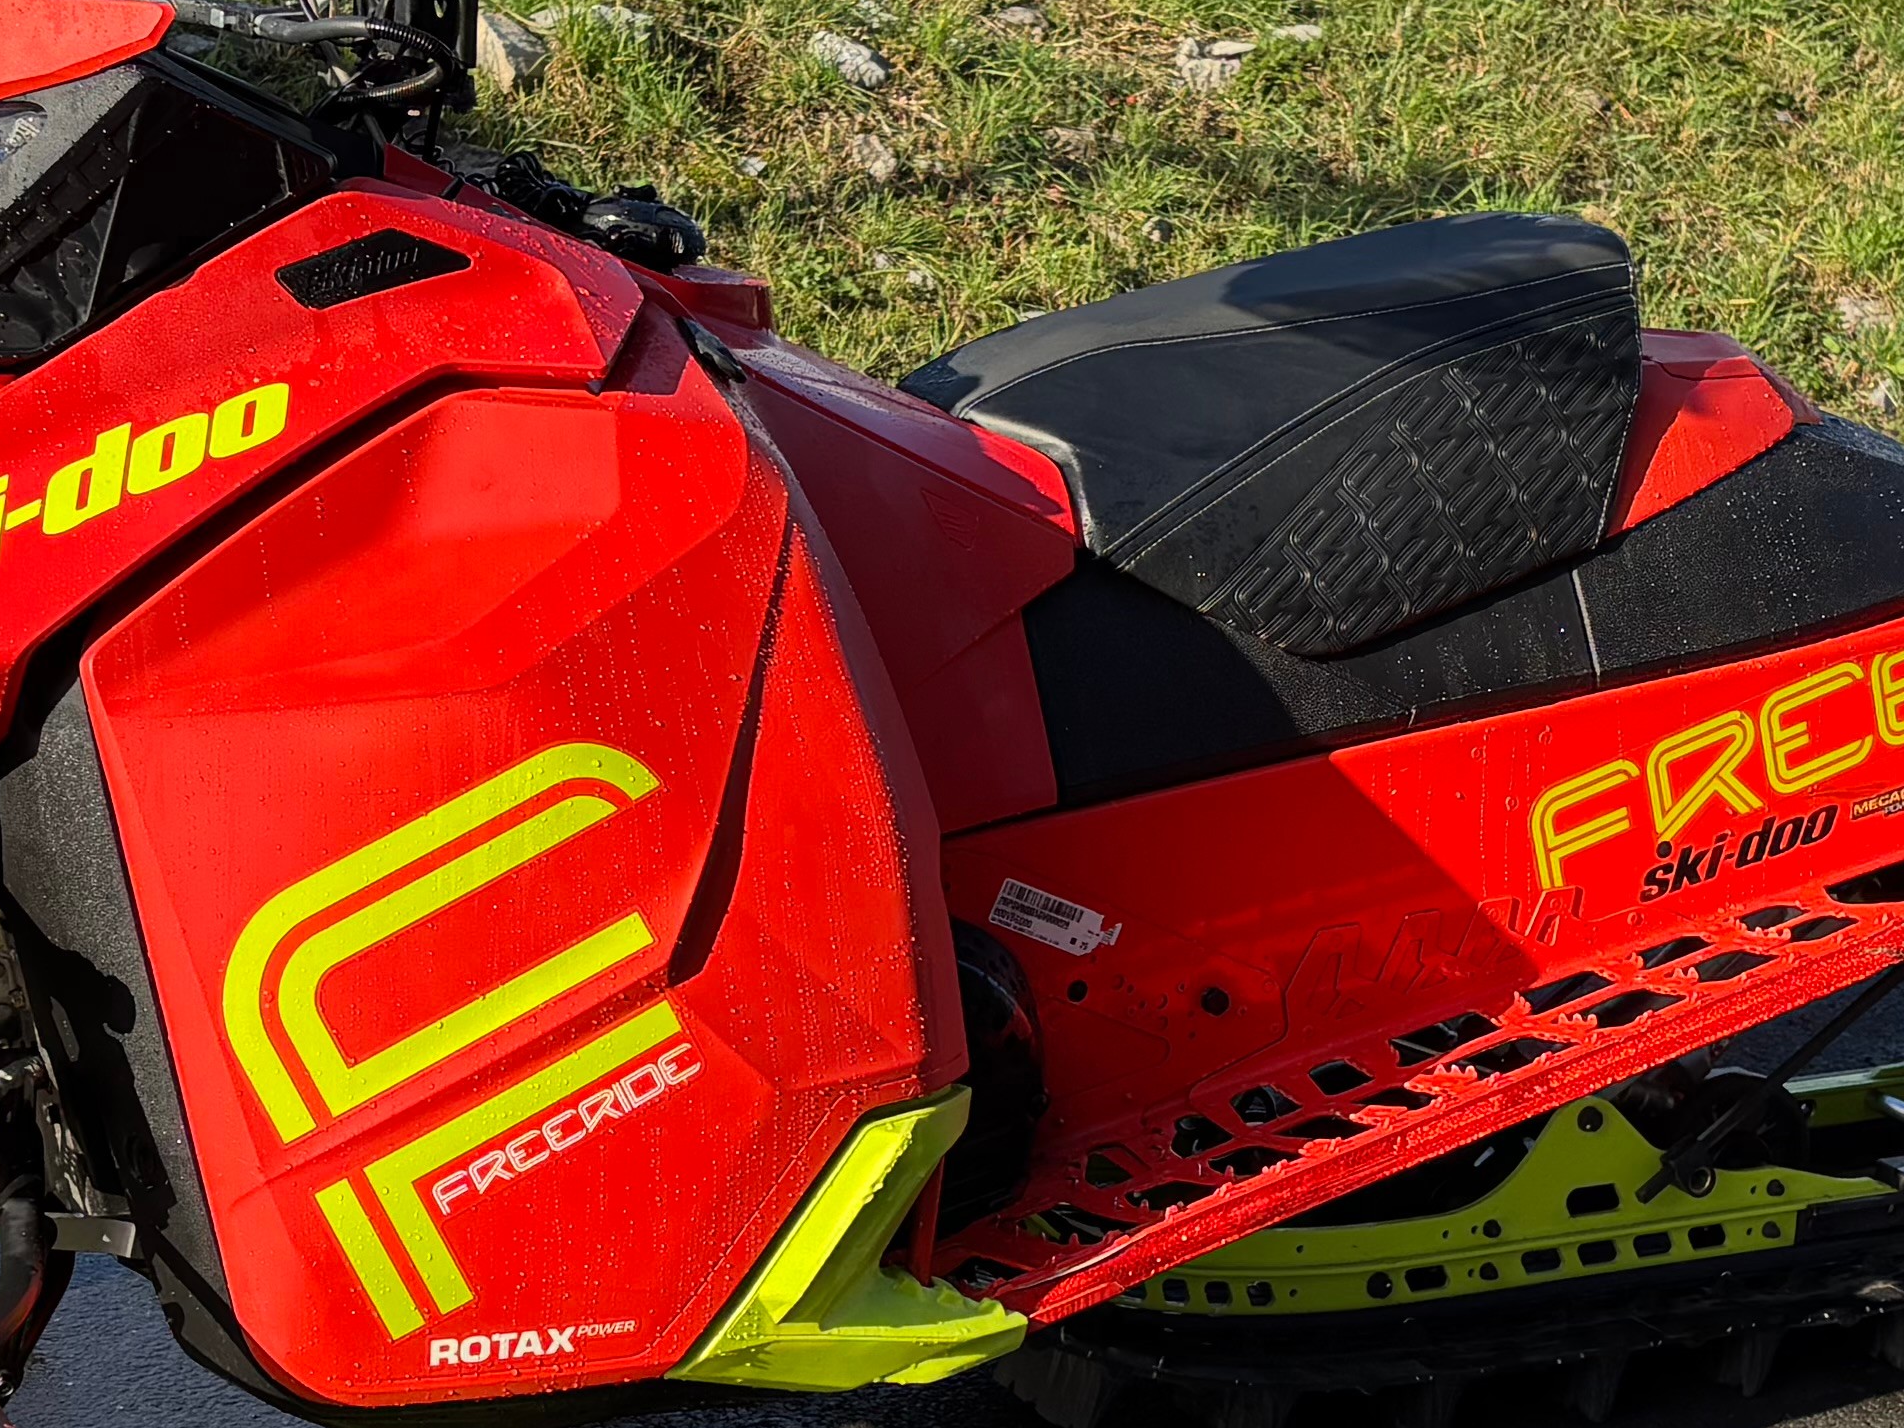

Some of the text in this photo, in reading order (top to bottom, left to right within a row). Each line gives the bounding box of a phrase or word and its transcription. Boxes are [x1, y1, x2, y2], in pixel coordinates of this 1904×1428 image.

[1640, 804, 1840, 903] ski-doo
[431, 1042, 702, 1216] FREERIDE
[429, 1320, 636, 1367] ROTAX POWER
